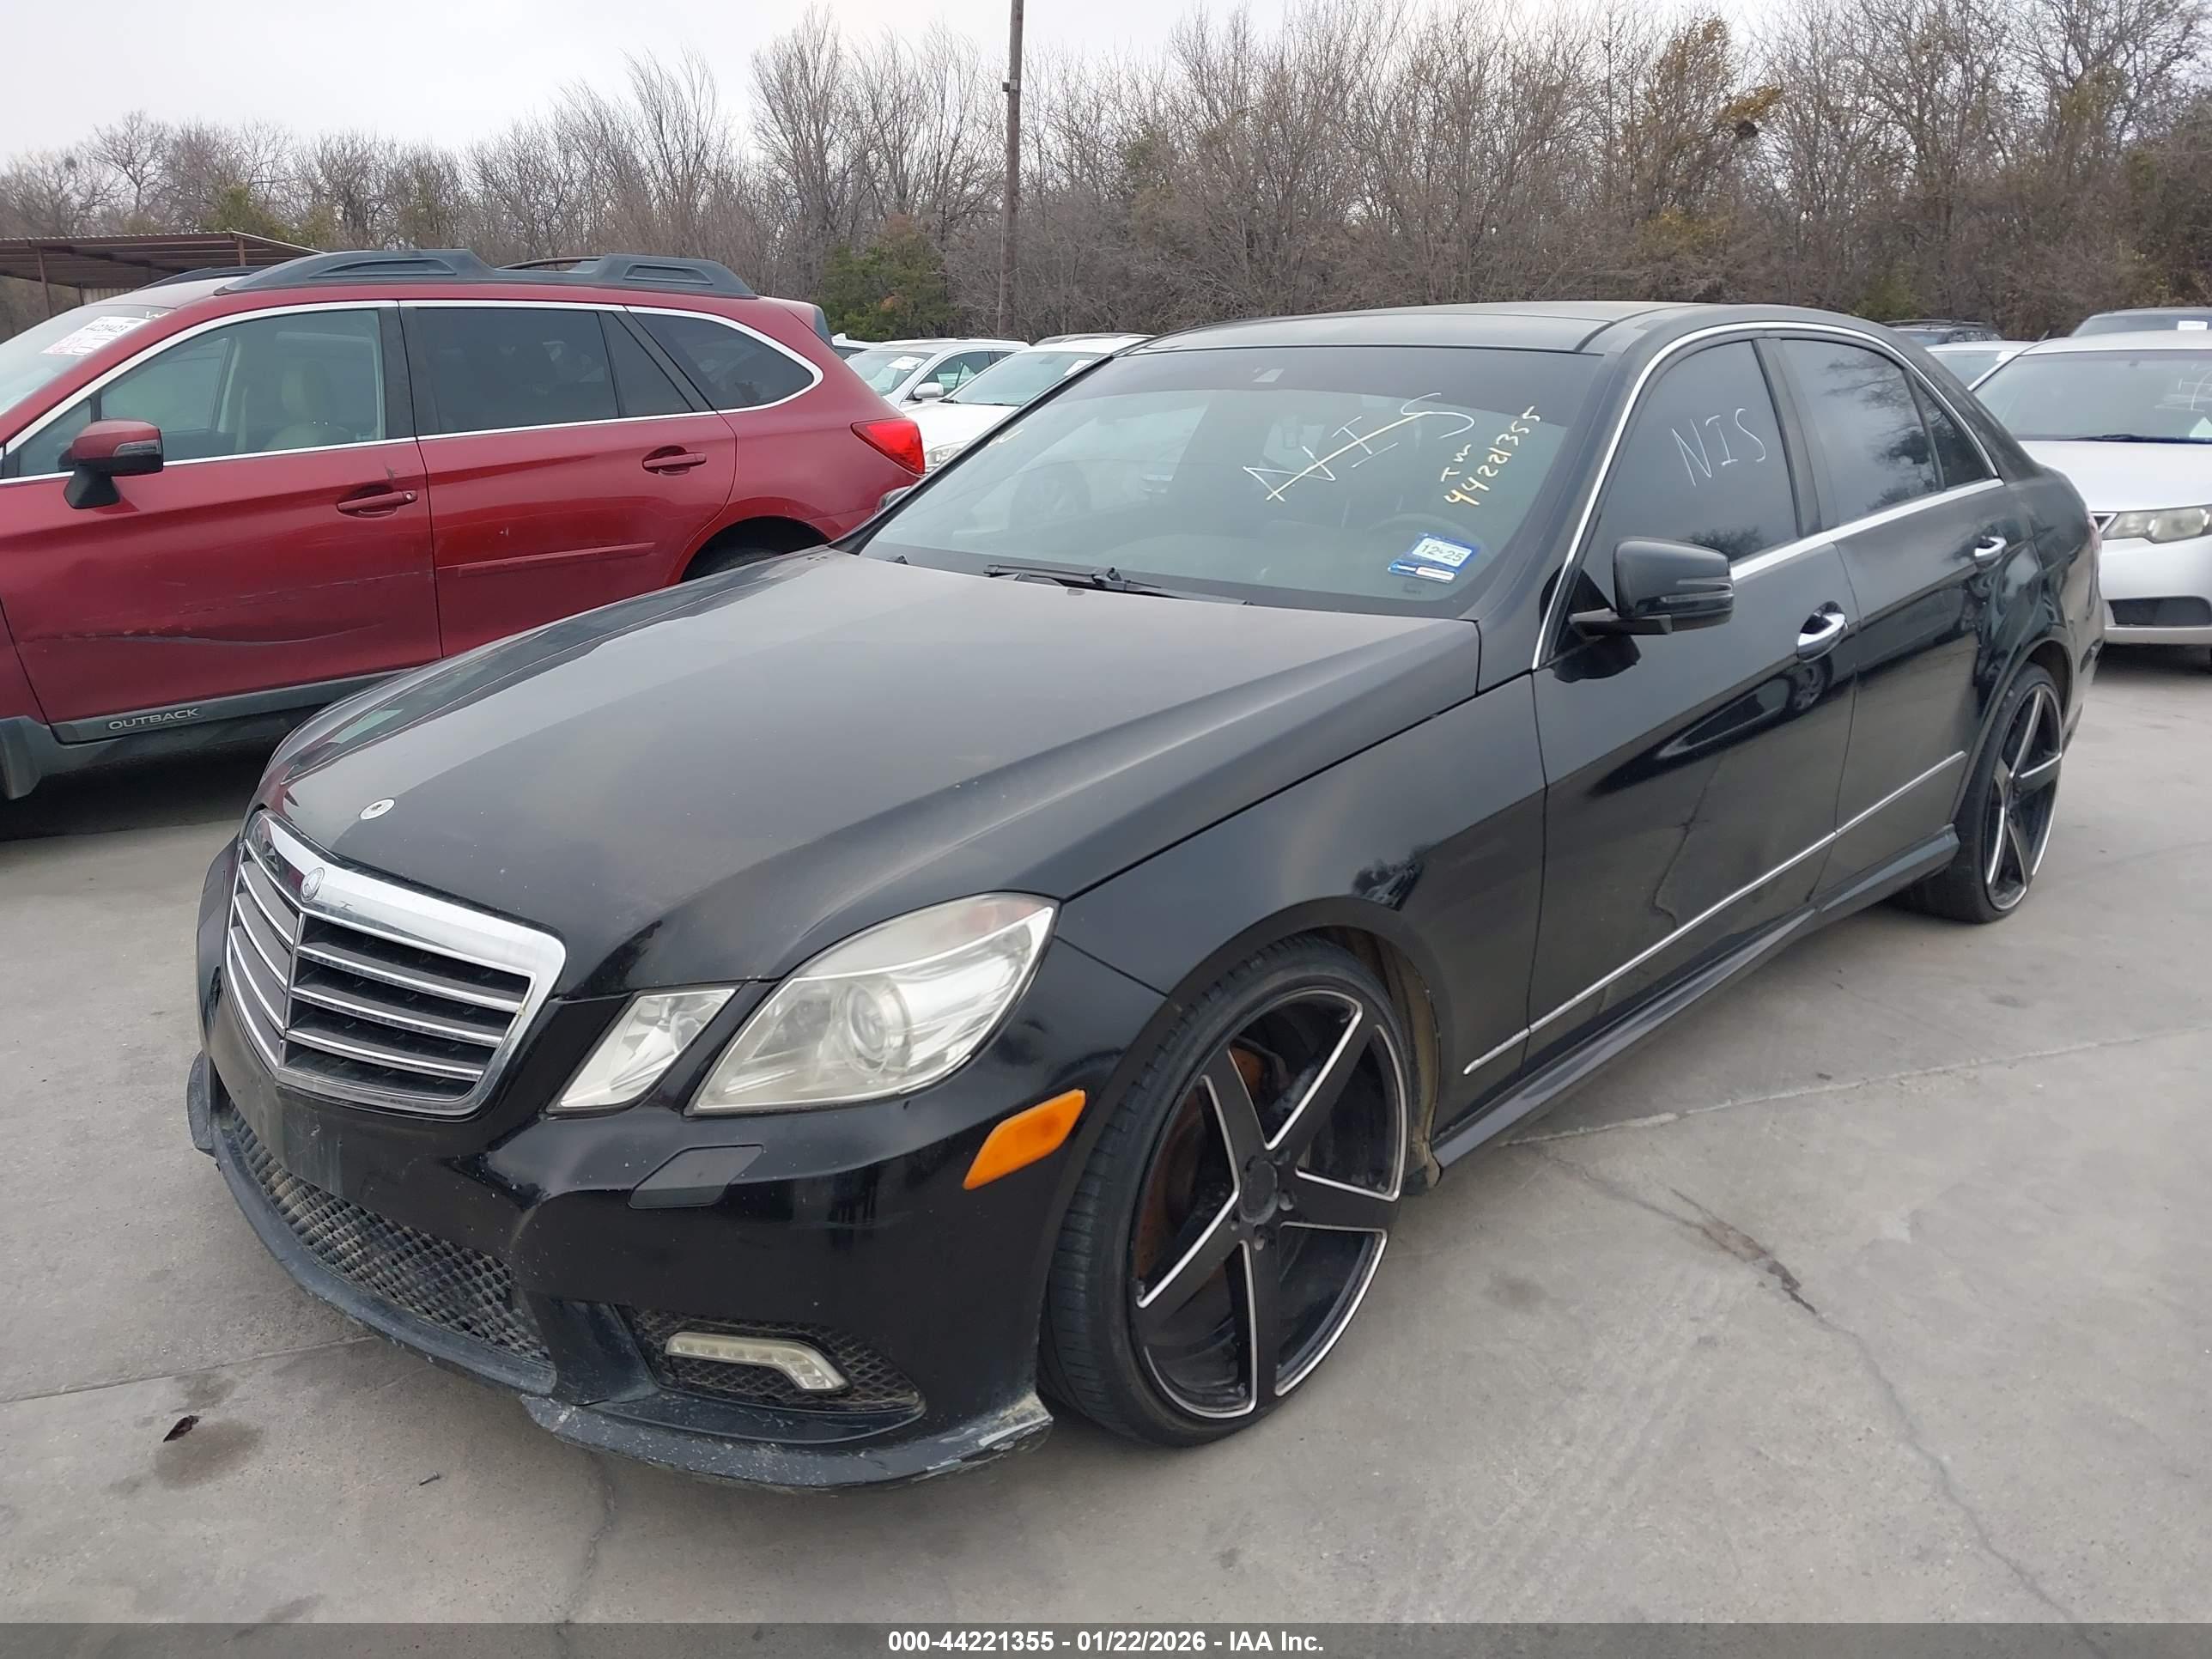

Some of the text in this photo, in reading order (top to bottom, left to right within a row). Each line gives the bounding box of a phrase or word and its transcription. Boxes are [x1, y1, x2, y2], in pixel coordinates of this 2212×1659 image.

[1242, 392, 1475, 502] NIS
[1443, 404, 1541, 506] 44221355
[1670, 407, 1767, 488] NIS
[108, 708, 200, 730] OUTBACK
